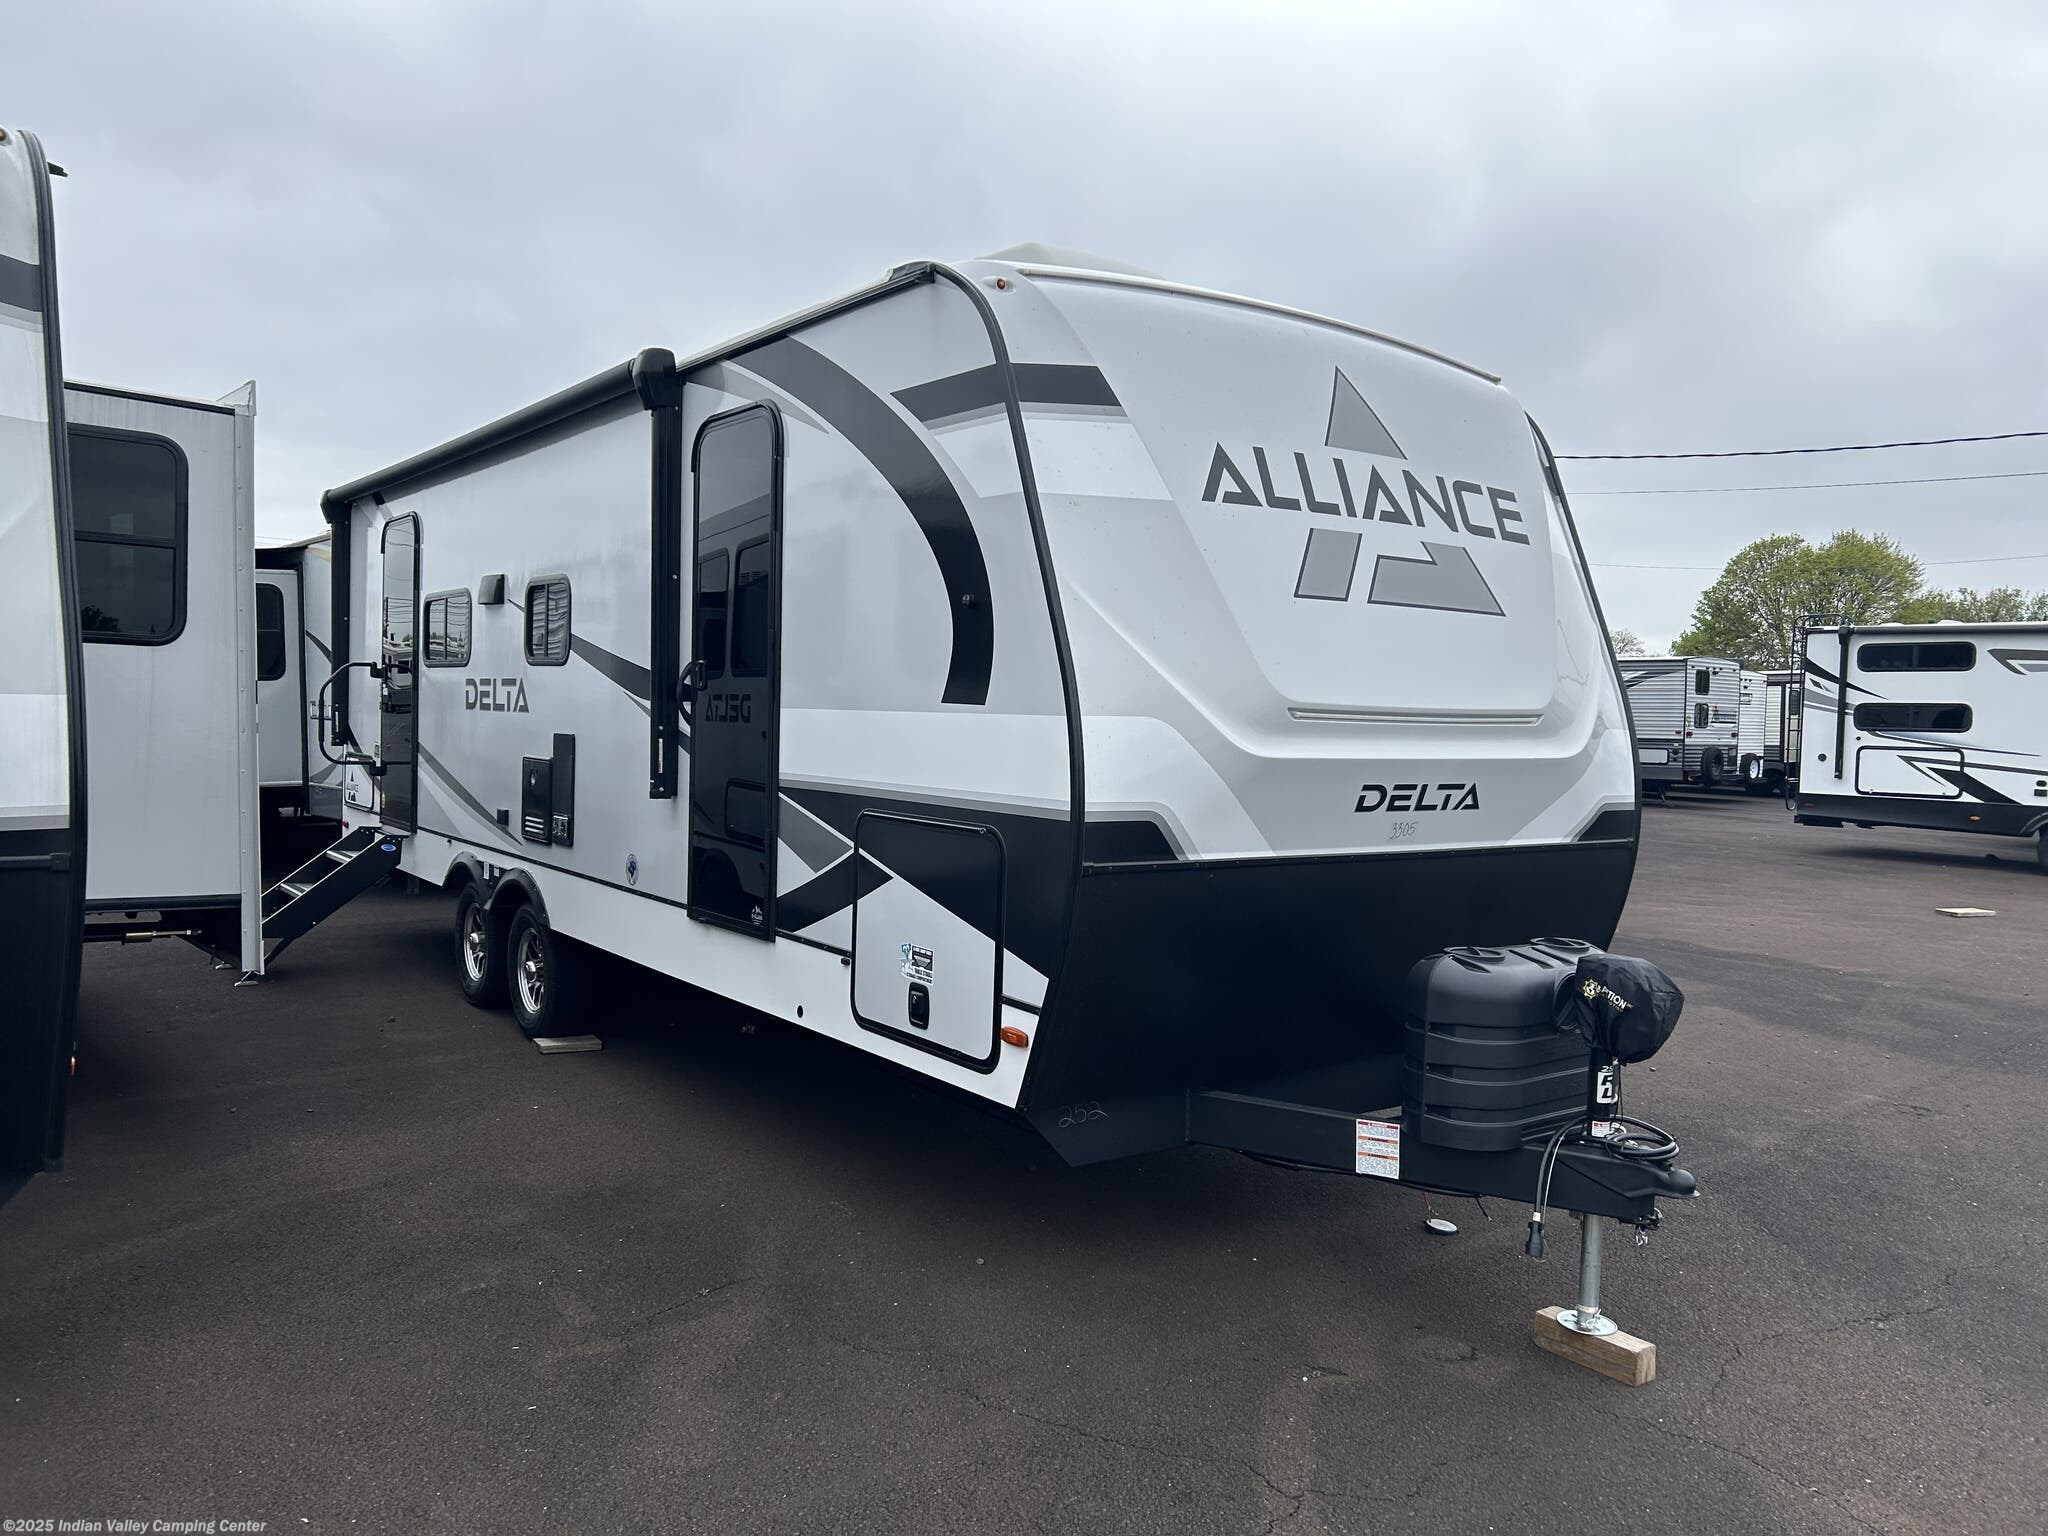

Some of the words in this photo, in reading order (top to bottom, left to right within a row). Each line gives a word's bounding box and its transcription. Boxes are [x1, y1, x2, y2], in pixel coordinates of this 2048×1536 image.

[1201, 441, 1530, 545] ALLIANCE
[465, 677, 529, 713] DELTA
[1354, 782, 1480, 813] DELTA
[1389, 821, 1418, 839] 3305
